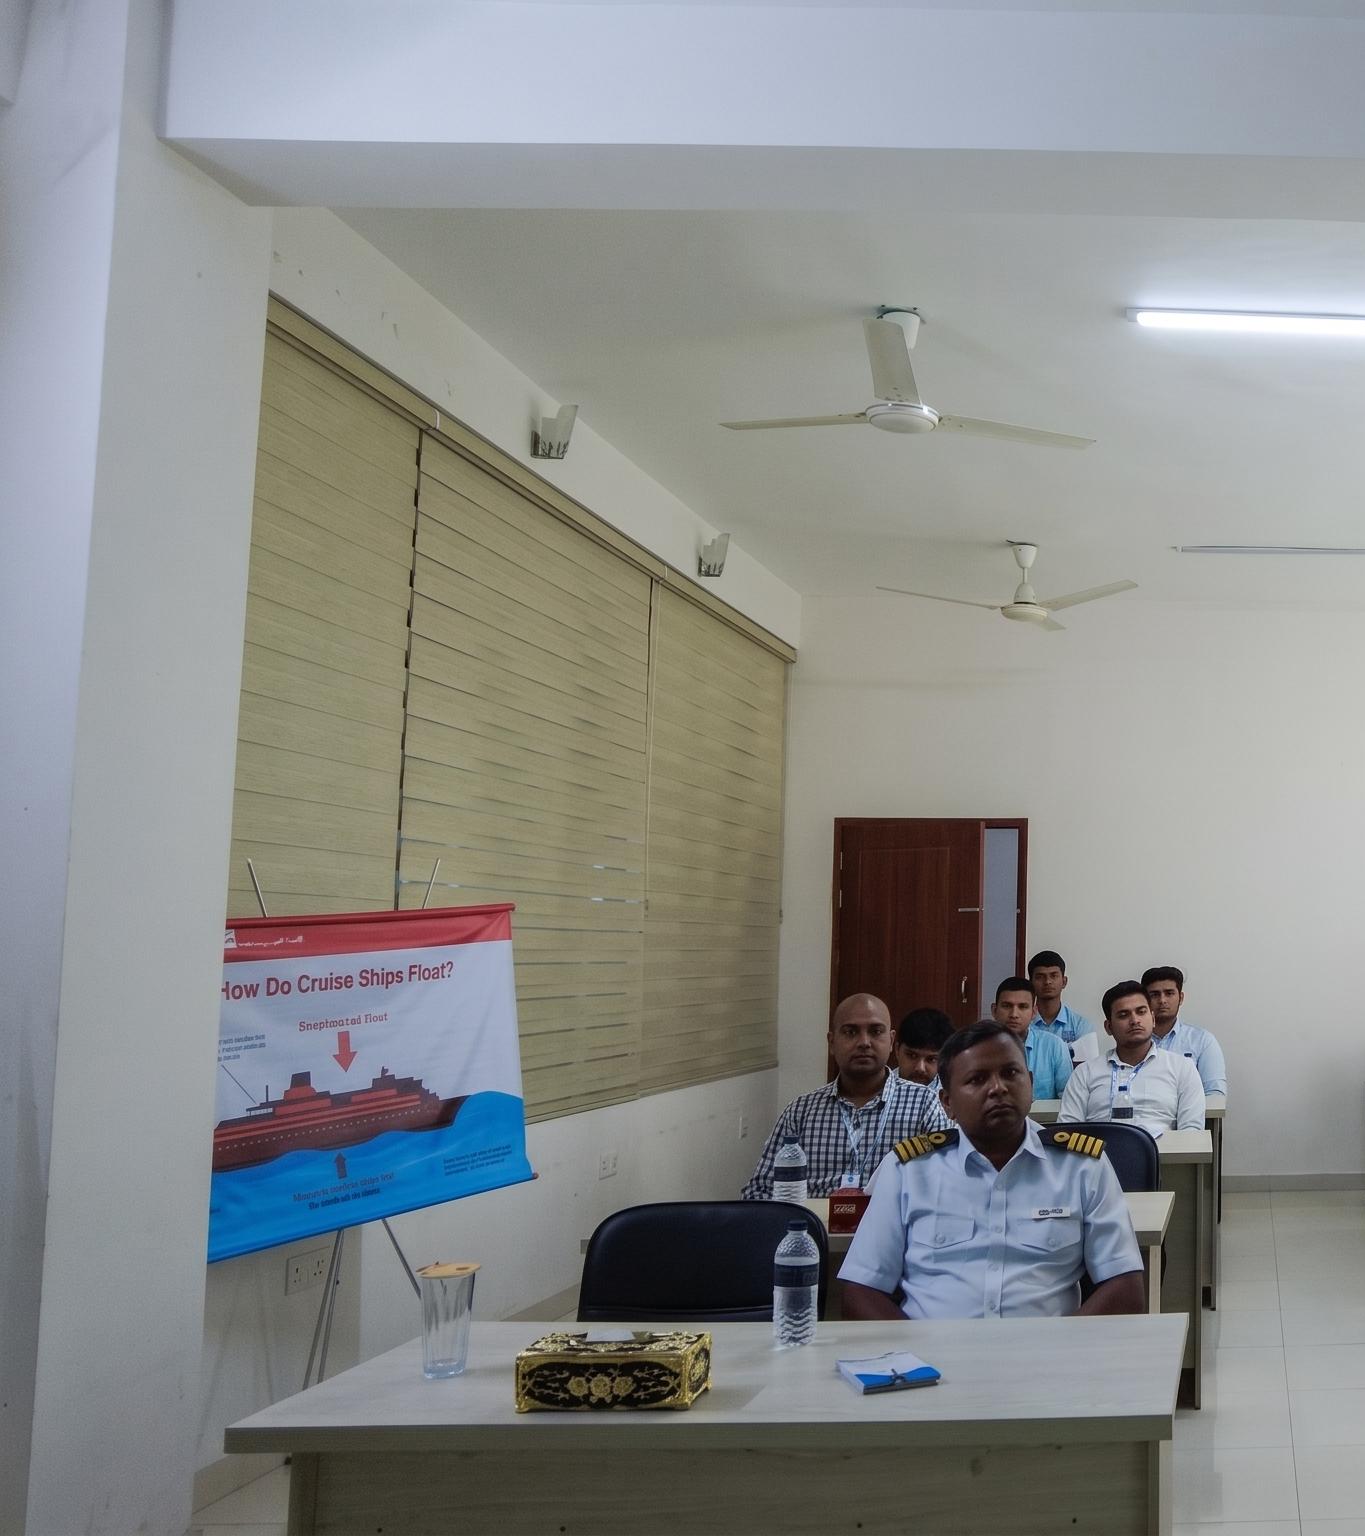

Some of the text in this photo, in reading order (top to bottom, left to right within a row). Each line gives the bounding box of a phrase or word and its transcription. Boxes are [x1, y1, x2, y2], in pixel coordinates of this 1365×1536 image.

[266, 977, 292, 996] Do
[297, 972, 354, 993] Cruise
[358, 968, 404, 989] Ships
[408, 961, 454, 982] Float?
